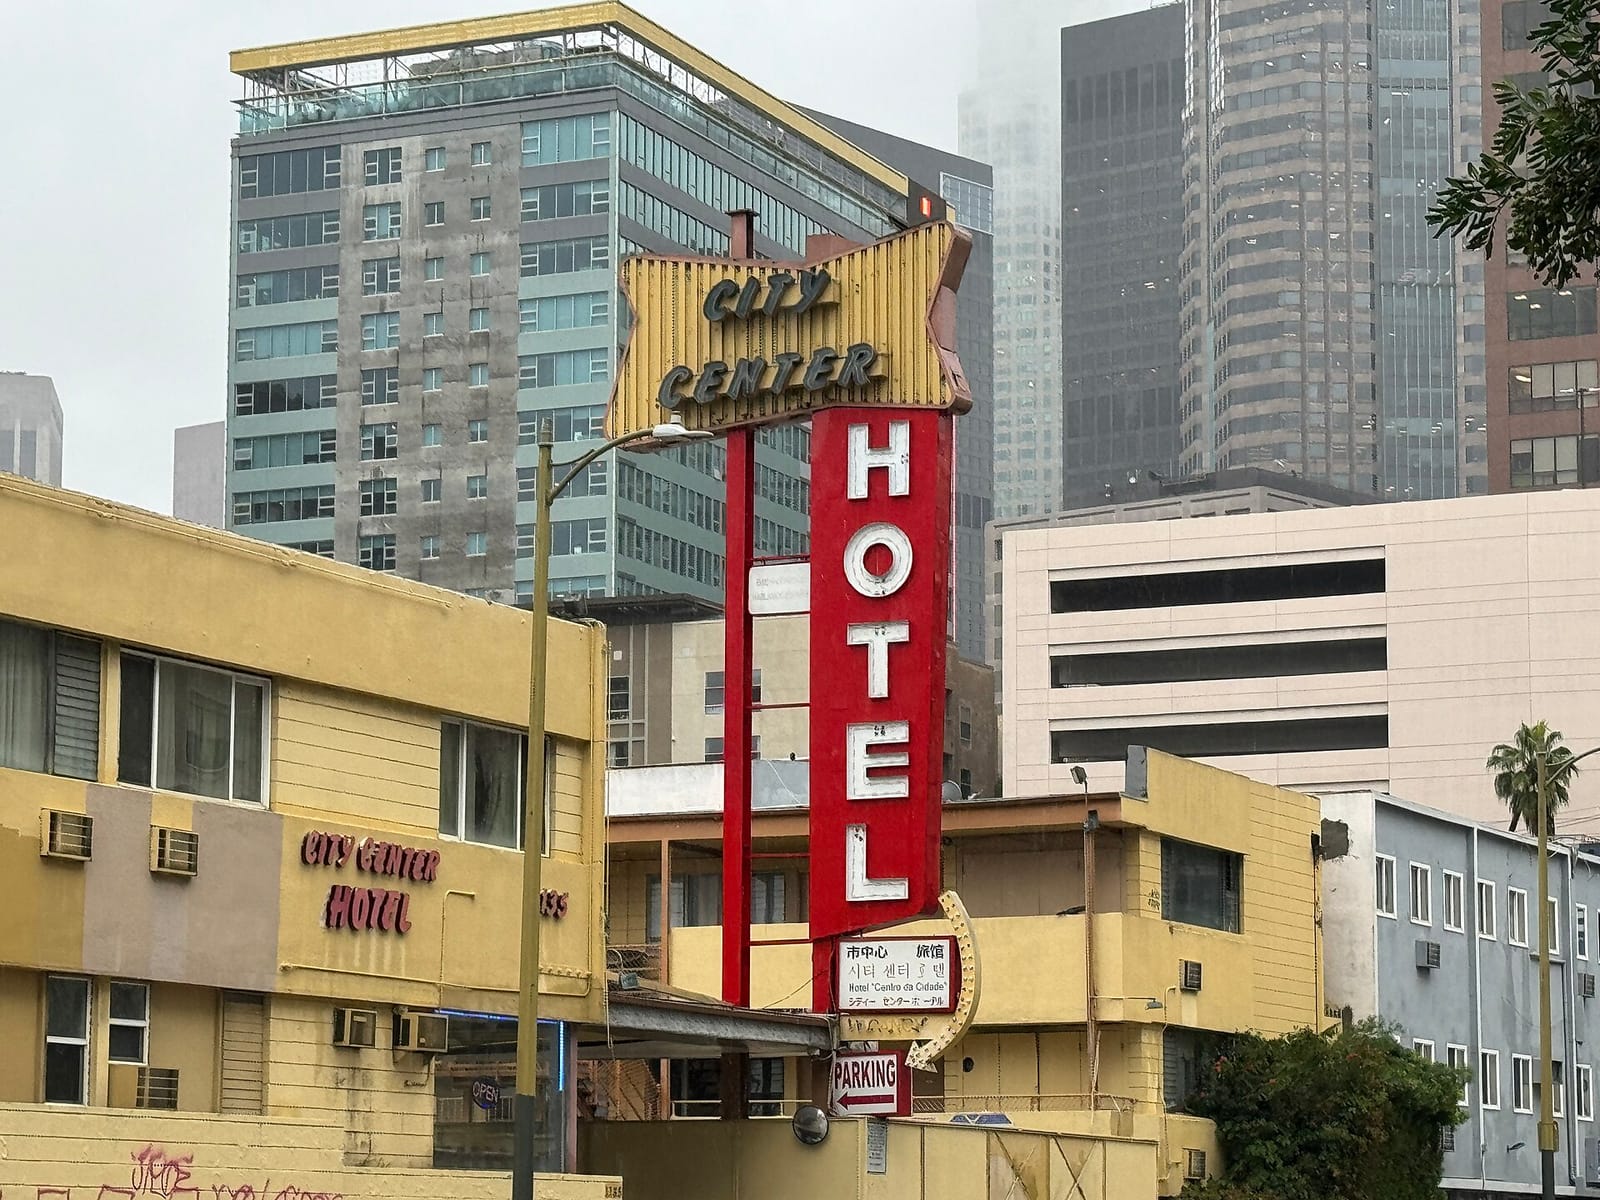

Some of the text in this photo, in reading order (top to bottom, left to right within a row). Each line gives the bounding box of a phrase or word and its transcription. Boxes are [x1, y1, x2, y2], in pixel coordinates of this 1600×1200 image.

[703, 269, 832, 322] CITY
[658, 342, 878, 409] CENTER
[843, 420, 913, 902] HOTEL
[301, 830, 440, 881] CITY CENTER
[325, 885, 412, 933] HOTEL
[846, 945, 889, 960] 市中心
[849, 983, 870, 992] Hotel
[472, 1081, 499, 1103] OPEN
[834, 1059, 896, 1090] PARKING
